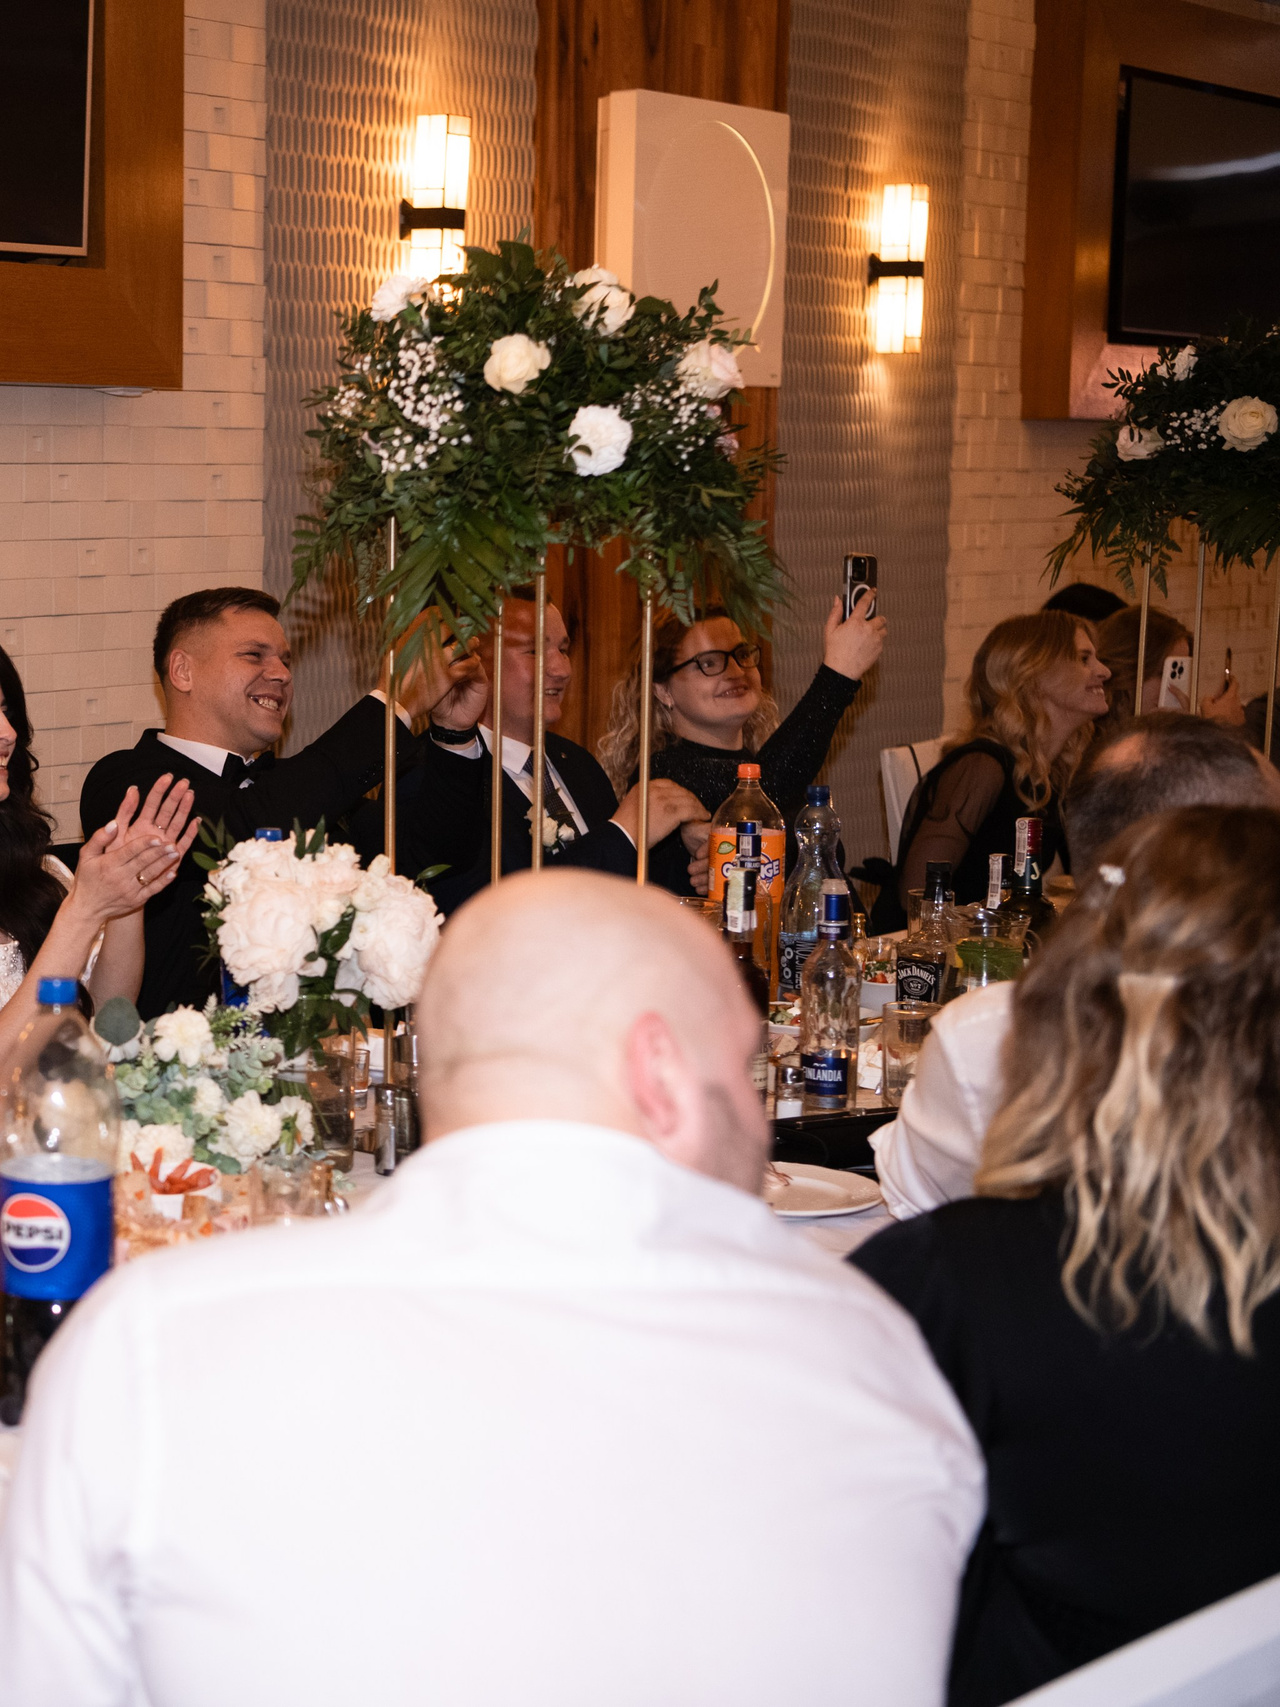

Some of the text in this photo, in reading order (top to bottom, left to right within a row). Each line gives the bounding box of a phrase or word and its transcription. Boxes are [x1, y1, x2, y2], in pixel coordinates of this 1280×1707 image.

[897, 965, 936, 985] JACK DANIEL'S
[802, 1066, 843, 1082] FINLANDIA
[5, 1222, 63, 1241] PEPSI
